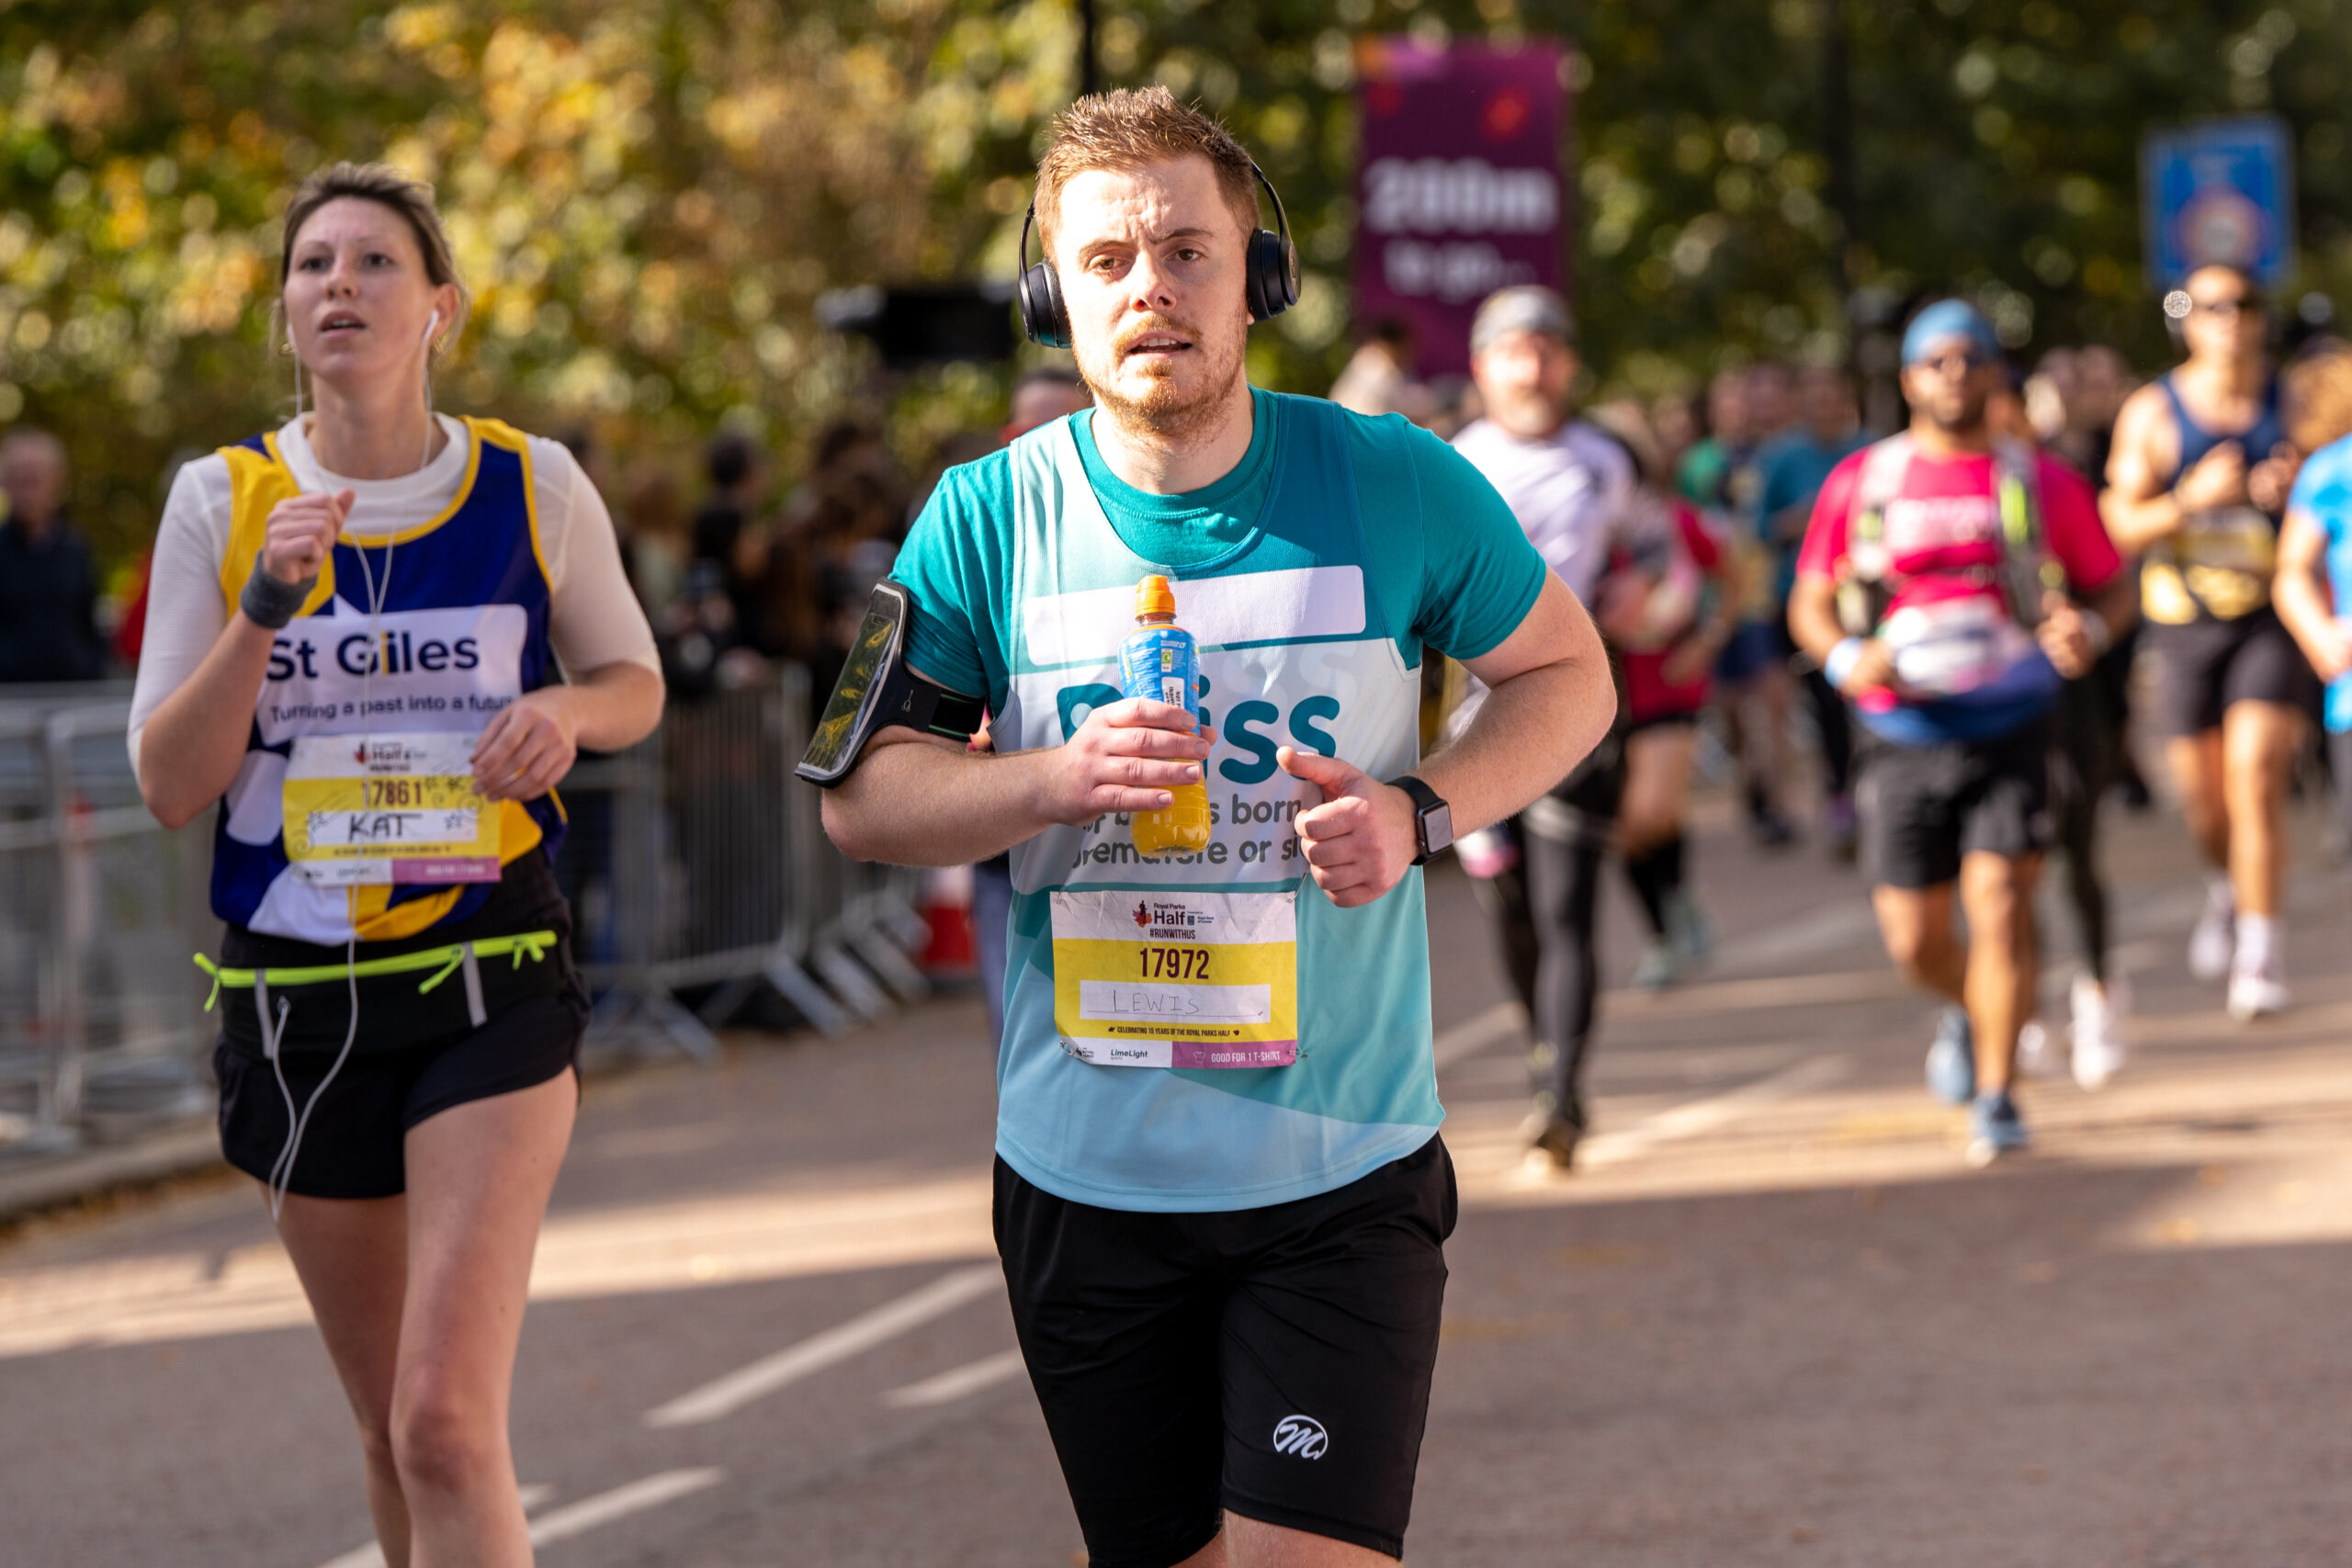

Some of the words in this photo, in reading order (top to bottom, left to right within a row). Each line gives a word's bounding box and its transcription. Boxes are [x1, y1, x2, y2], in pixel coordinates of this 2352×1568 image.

[266, 637, 318, 681] St
[337, 630, 479, 676] Giles
[270, 704, 337, 723] Turning
[343, 702, 355, 716] a
[360, 695, 402, 717] past
[408, 694, 447, 712] into
[451, 697, 464, 712] a
[363, 779, 422, 806] 7861
[1232, 793, 1302, 824] born
[347, 813, 423, 843] KAT
[1238, 840, 1272, 863] or
[1154, 910, 1185, 925] Half
[1149, 928, 1195, 940] #RUNWITHUS
[1139, 947, 1209, 979] 17972
[1112, 989, 1200, 1015] LEWIS
[1117, 1026, 1147, 1034] CELEBRATING
[1155, 1027, 1170, 1035] YEARS
[1110, 1049, 1148, 1059] LimeLight
[1211, 1053, 1230, 1063] GOOD
[1232, 1053, 1245, 1062] FOR
[1249, 1052, 1251, 1062] 1
[1253, 1051, 1281, 1061] T-SHIRT
